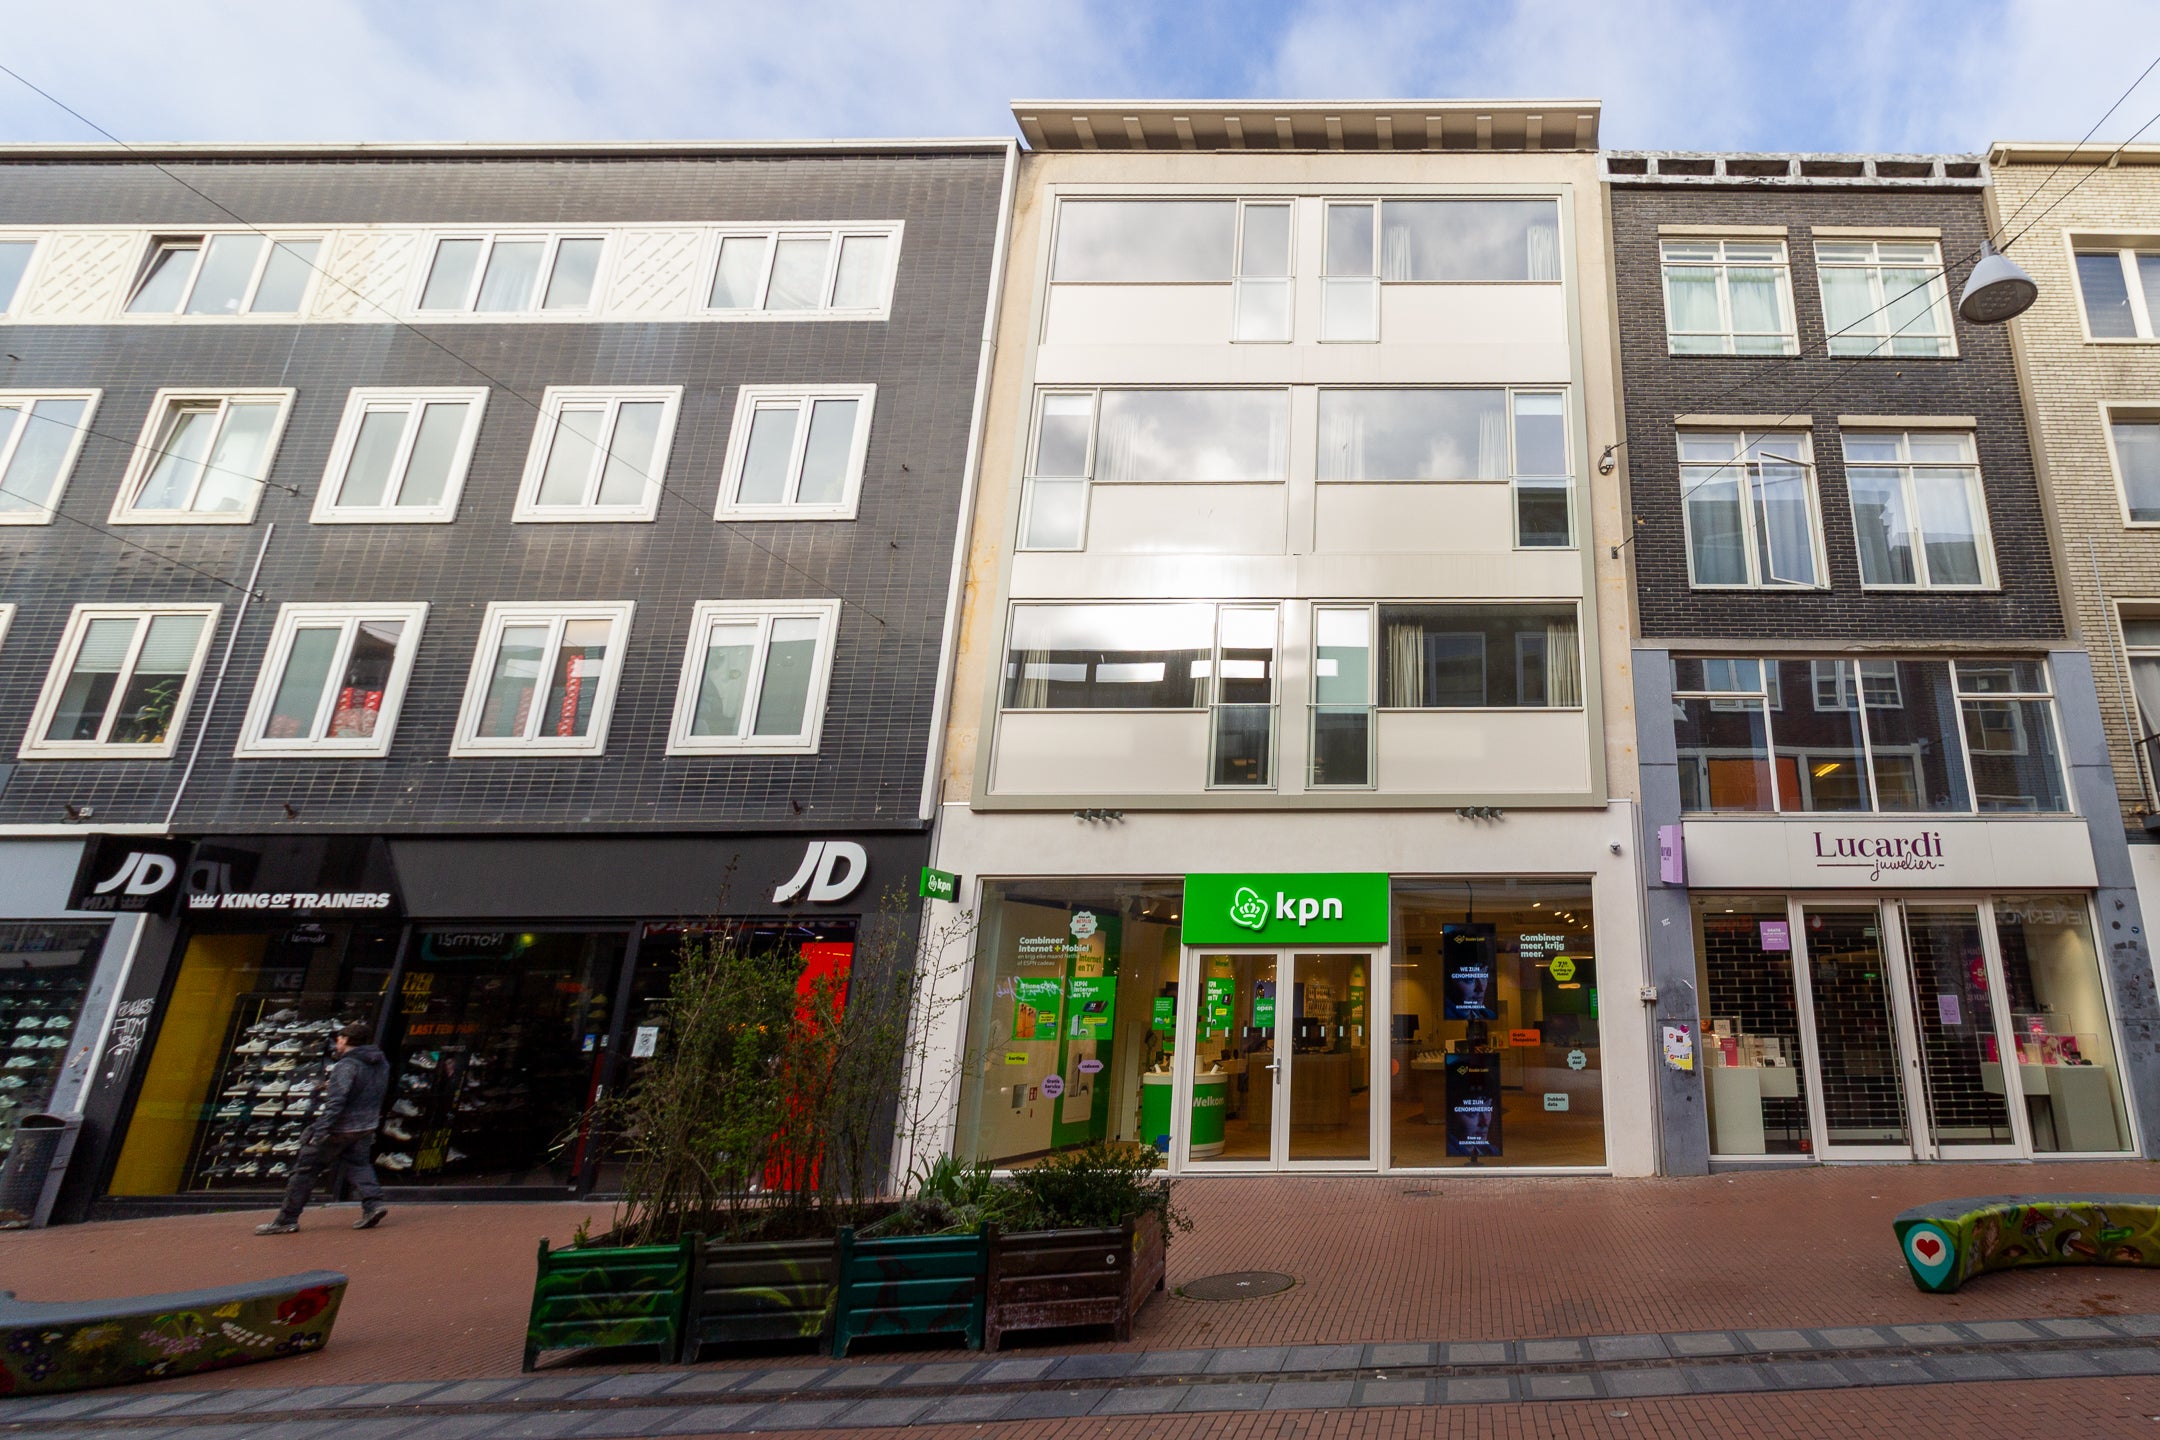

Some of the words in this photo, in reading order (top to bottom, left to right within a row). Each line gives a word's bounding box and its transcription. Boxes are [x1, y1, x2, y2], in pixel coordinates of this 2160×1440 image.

[1813, 832, 1943, 858] Lucardi
[93, 851, 177, 895] JD
[772, 841, 868, 902] JD
[1870, 851, 1937, 882] juwelier
[937, 878, 951, 893] kpn
[220, 893, 270, 909] KING
[270, 894, 292, 908] OF
[292, 892, 391, 909] TRAINERS
[1275, 891, 1343, 926] kpn
[1019, 936, 1065, 945] Combineer
[1520, 934, 1565, 942] Combineer
[1018, 944, 1053, 953] Internet
[1061, 944, 1089, 953] Mobiel
[1544, 942, 1565, 950] krijg
[1079, 953, 1102, 964] Internet
[1086, 964, 1095, 972] TV
[409, 1023, 435, 1036] LAST
